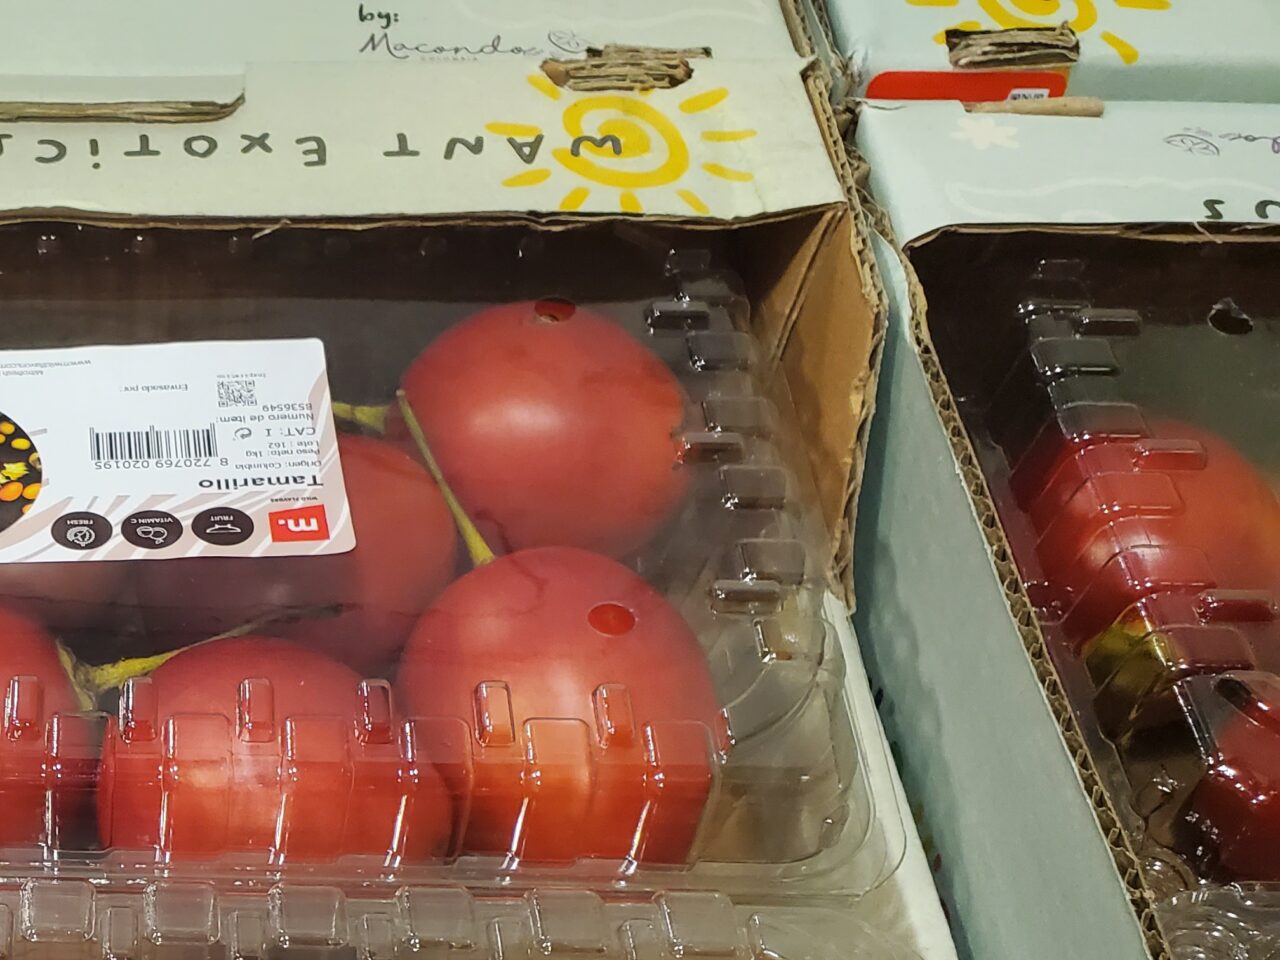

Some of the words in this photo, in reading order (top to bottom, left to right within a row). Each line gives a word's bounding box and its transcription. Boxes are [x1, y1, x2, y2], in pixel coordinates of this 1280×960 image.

[358, 3, 399, 29] by:
[383, 133, 623, 165] WANT
[249, 414, 265, 422] de
[267, 413, 314, 422] Numero
[280, 427, 316, 437] CAT:
[94, 459, 150, 470] 020195
[155, 458, 212, 469] 720769
[220, 457, 229, 467] 8
[198, 475, 324, 491] Tamarillo
